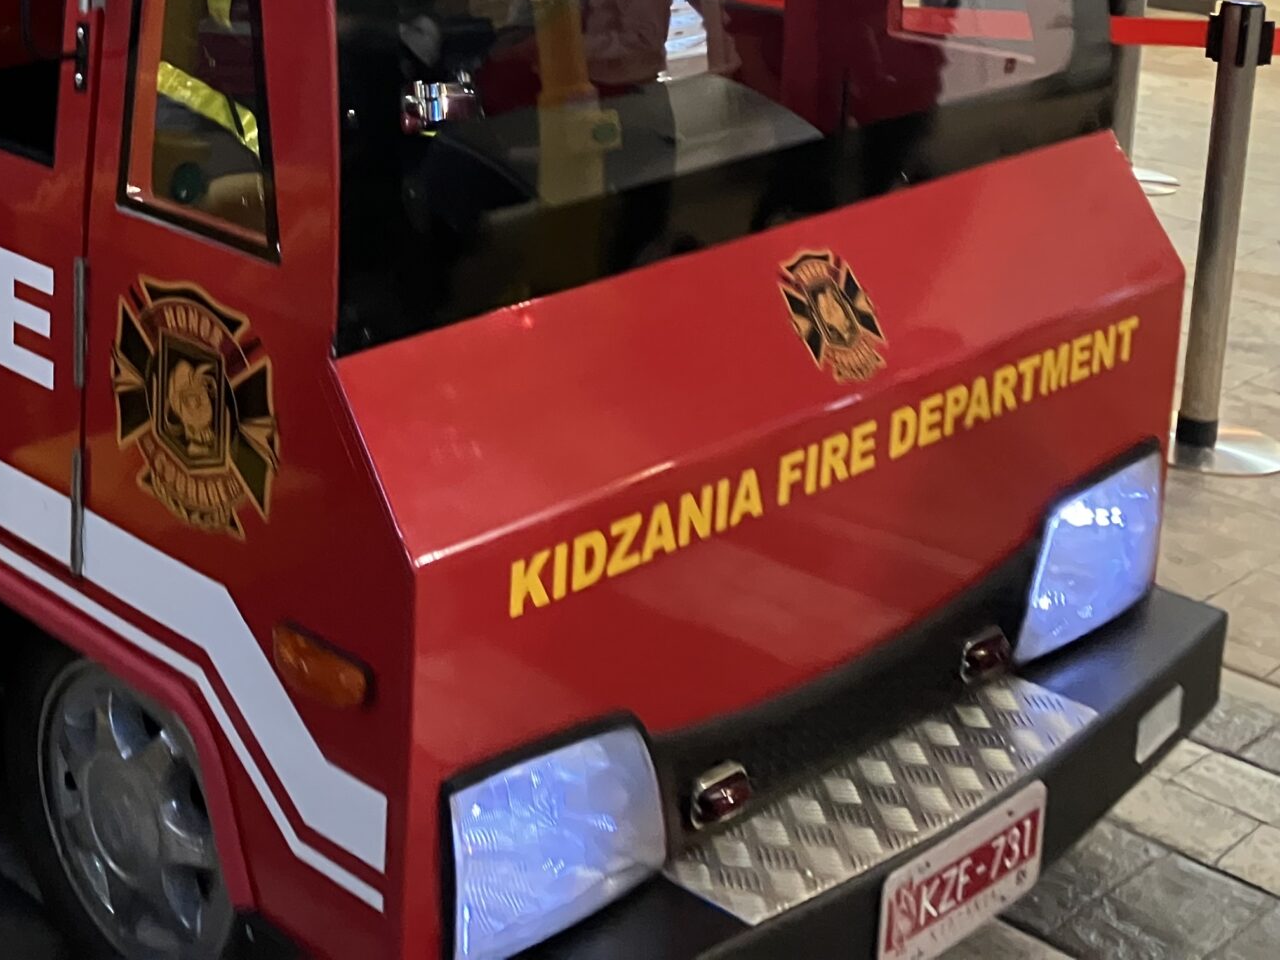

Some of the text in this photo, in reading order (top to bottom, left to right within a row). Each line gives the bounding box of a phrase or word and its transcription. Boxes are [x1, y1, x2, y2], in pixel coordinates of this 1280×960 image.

[509, 315, 1140, 619] KIDZANIA FIRE DEPARTMENT
[920, 818, 1033, 927] KZF-731
